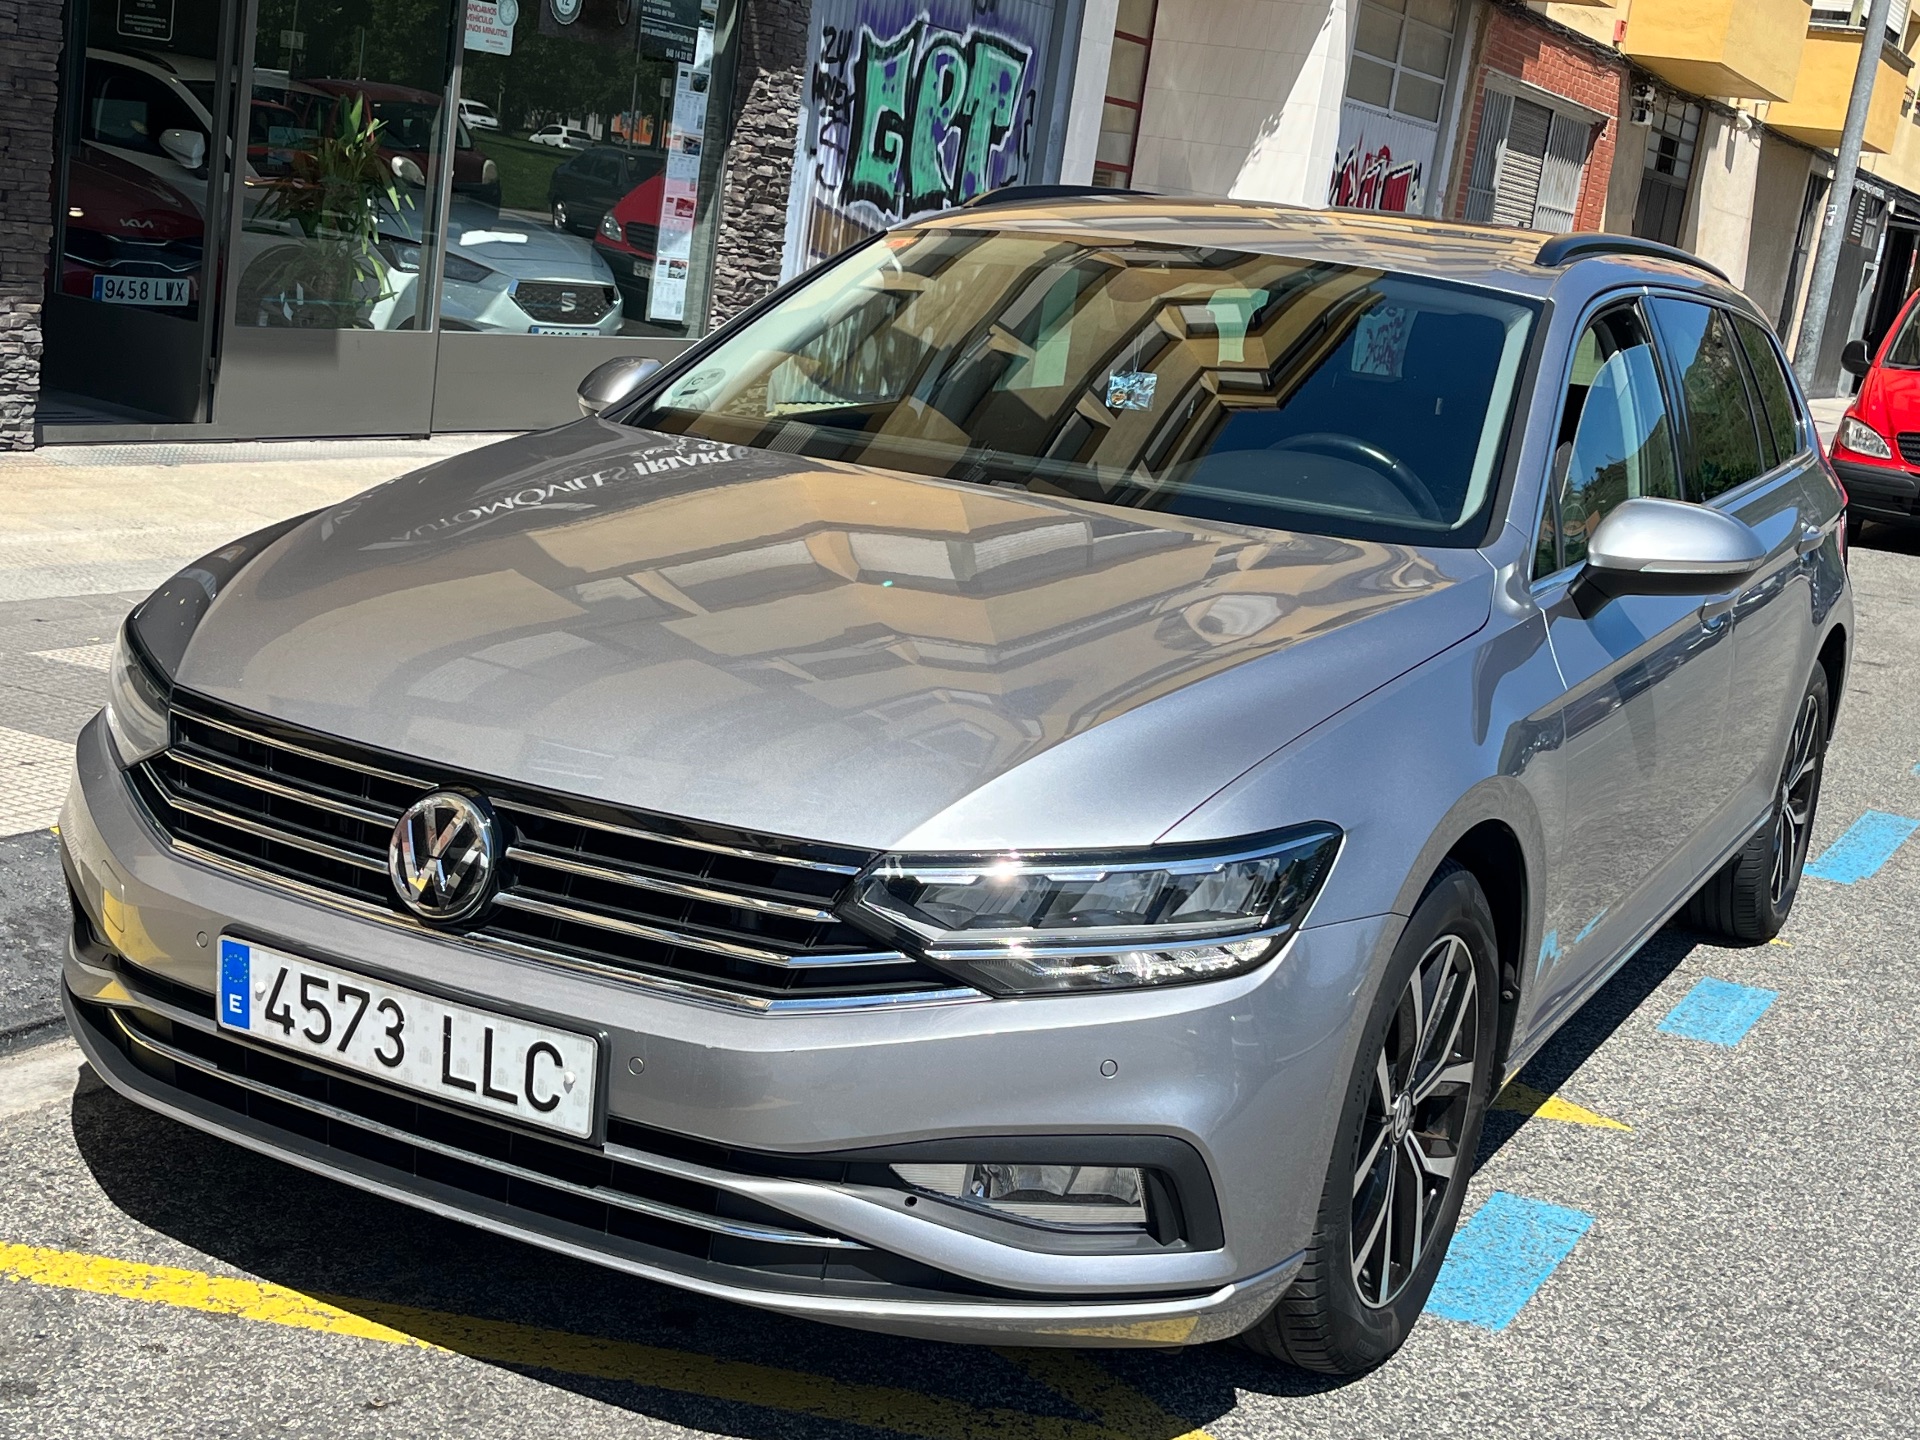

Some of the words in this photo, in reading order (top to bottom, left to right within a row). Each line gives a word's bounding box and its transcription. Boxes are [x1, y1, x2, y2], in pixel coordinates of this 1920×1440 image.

[104, 279, 149, 301] 9458
[154, 281, 185, 301] LWX
[228, 994, 243, 1014] E
[264, 967, 405, 1068] 4573
[441, 1015, 563, 1113] LLC
